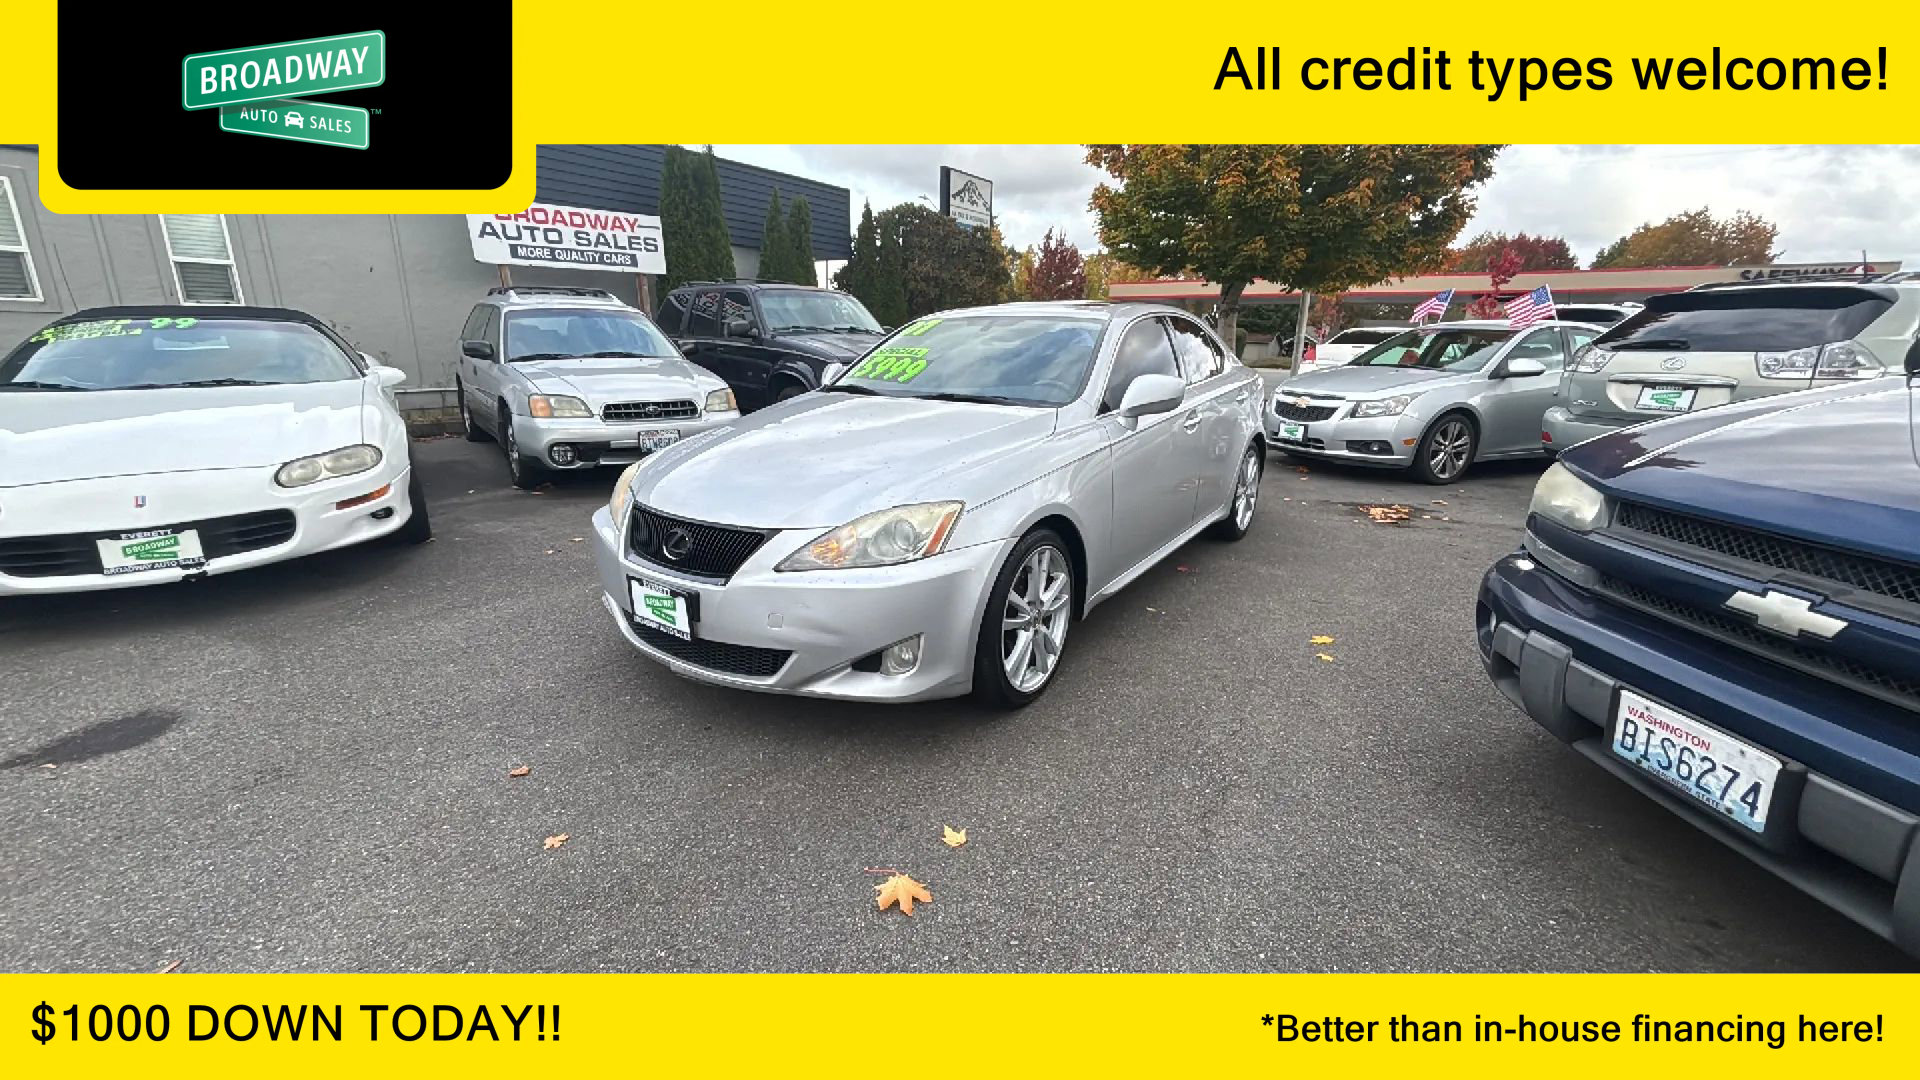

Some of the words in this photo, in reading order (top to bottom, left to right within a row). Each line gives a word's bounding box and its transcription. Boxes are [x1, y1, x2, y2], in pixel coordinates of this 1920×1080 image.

[477, 221, 564, 245] AUTO
[573, 229, 659, 253] SALES
[517, 245, 552, 260] MORE
[554, 249, 601, 263] QUALITY
[603, 253, 632, 265] CARS
[120, 530, 172, 540] EVERETT
[125, 538, 175, 554] BROADWAY
[103, 564, 152, 576] BROADWAY
[153, 560, 178, 569] AUTO
[1628, 706, 1711, 751] WASHINGTON
[1620, 718, 1762, 818] BIS6274
